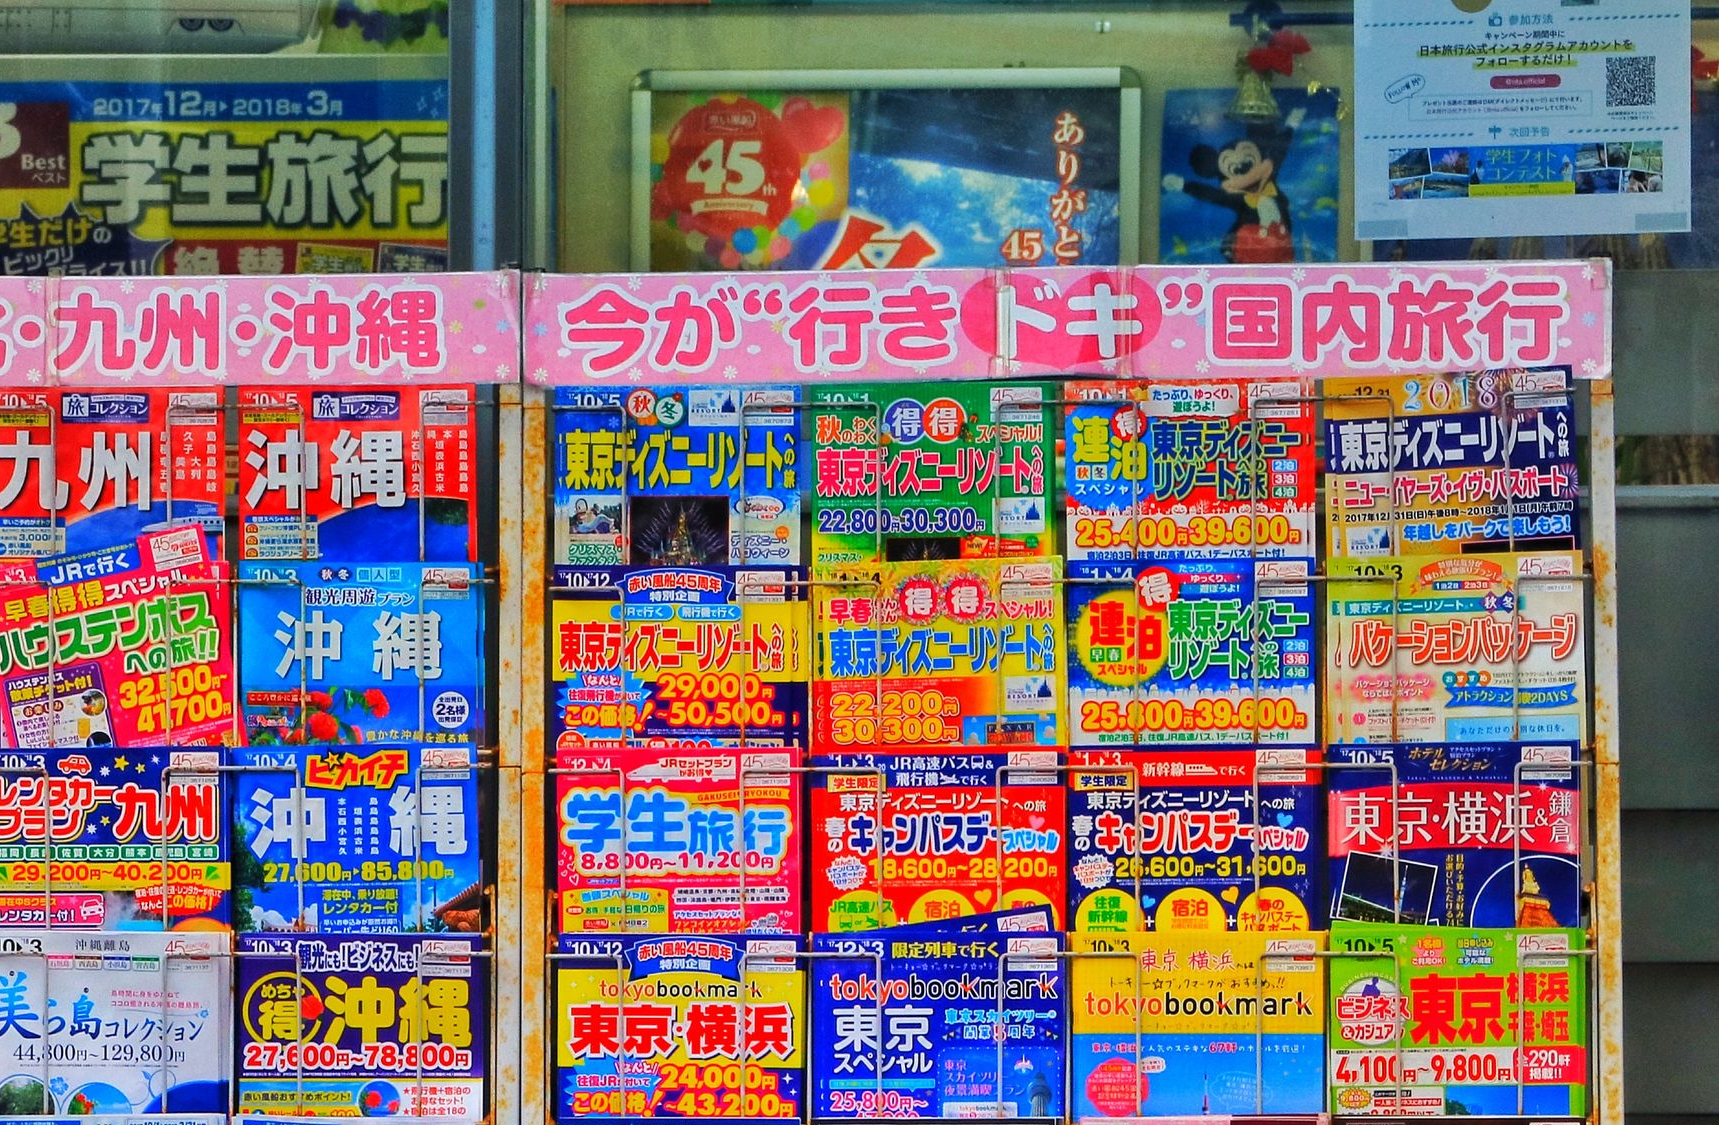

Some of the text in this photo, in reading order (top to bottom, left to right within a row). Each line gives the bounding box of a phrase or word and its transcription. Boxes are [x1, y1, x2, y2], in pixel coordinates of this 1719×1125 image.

[1508, 13, 1554, 26] 参加方法
[1508, 126, 1550, 138] 次回予告
[21, 154, 66, 172] Best
[1485, 147, 1557, 164] 学生フォト
[32, 172, 67, 184] ベスト
[684, 140, 778, 197] 45 th
[1487, 164, 1557, 181] コンテスト
[83, 133, 448, 226] 学生旅行
[1000, 231, 1042, 260] 45
[245, 430, 405, 509] 沖縄
[627, 574, 722, 591] 赤い風船45周年
[305, 588, 415, 608] 観光周遊プラン
[650, 590, 699, 603] 特別企画
[275, 611, 442, 682] 沖縄
[1349, 615, 1575, 669] バケーションパッケージ
[658, 673, 772, 699] 29,000円
[660, 757, 732, 770] JRセットプラン
[840, 792, 1010, 812] 東京ディズニーリゾート
[564, 791, 786, 857] 学生旅行
[925, 901, 961, 919] 宿泊
[76, 940, 129, 953] 沖縄離島
[892, 941, 998, 960] 限定列車で行く
[600, 979, 761, 1001] tokyobookmark
[325, 974, 471, 1048] 沖縄
[833, 1006, 932, 1052] 東京
[833, 1054, 932, 1075] スペシャル
[661, 1064, 775, 1090] 24,000円
